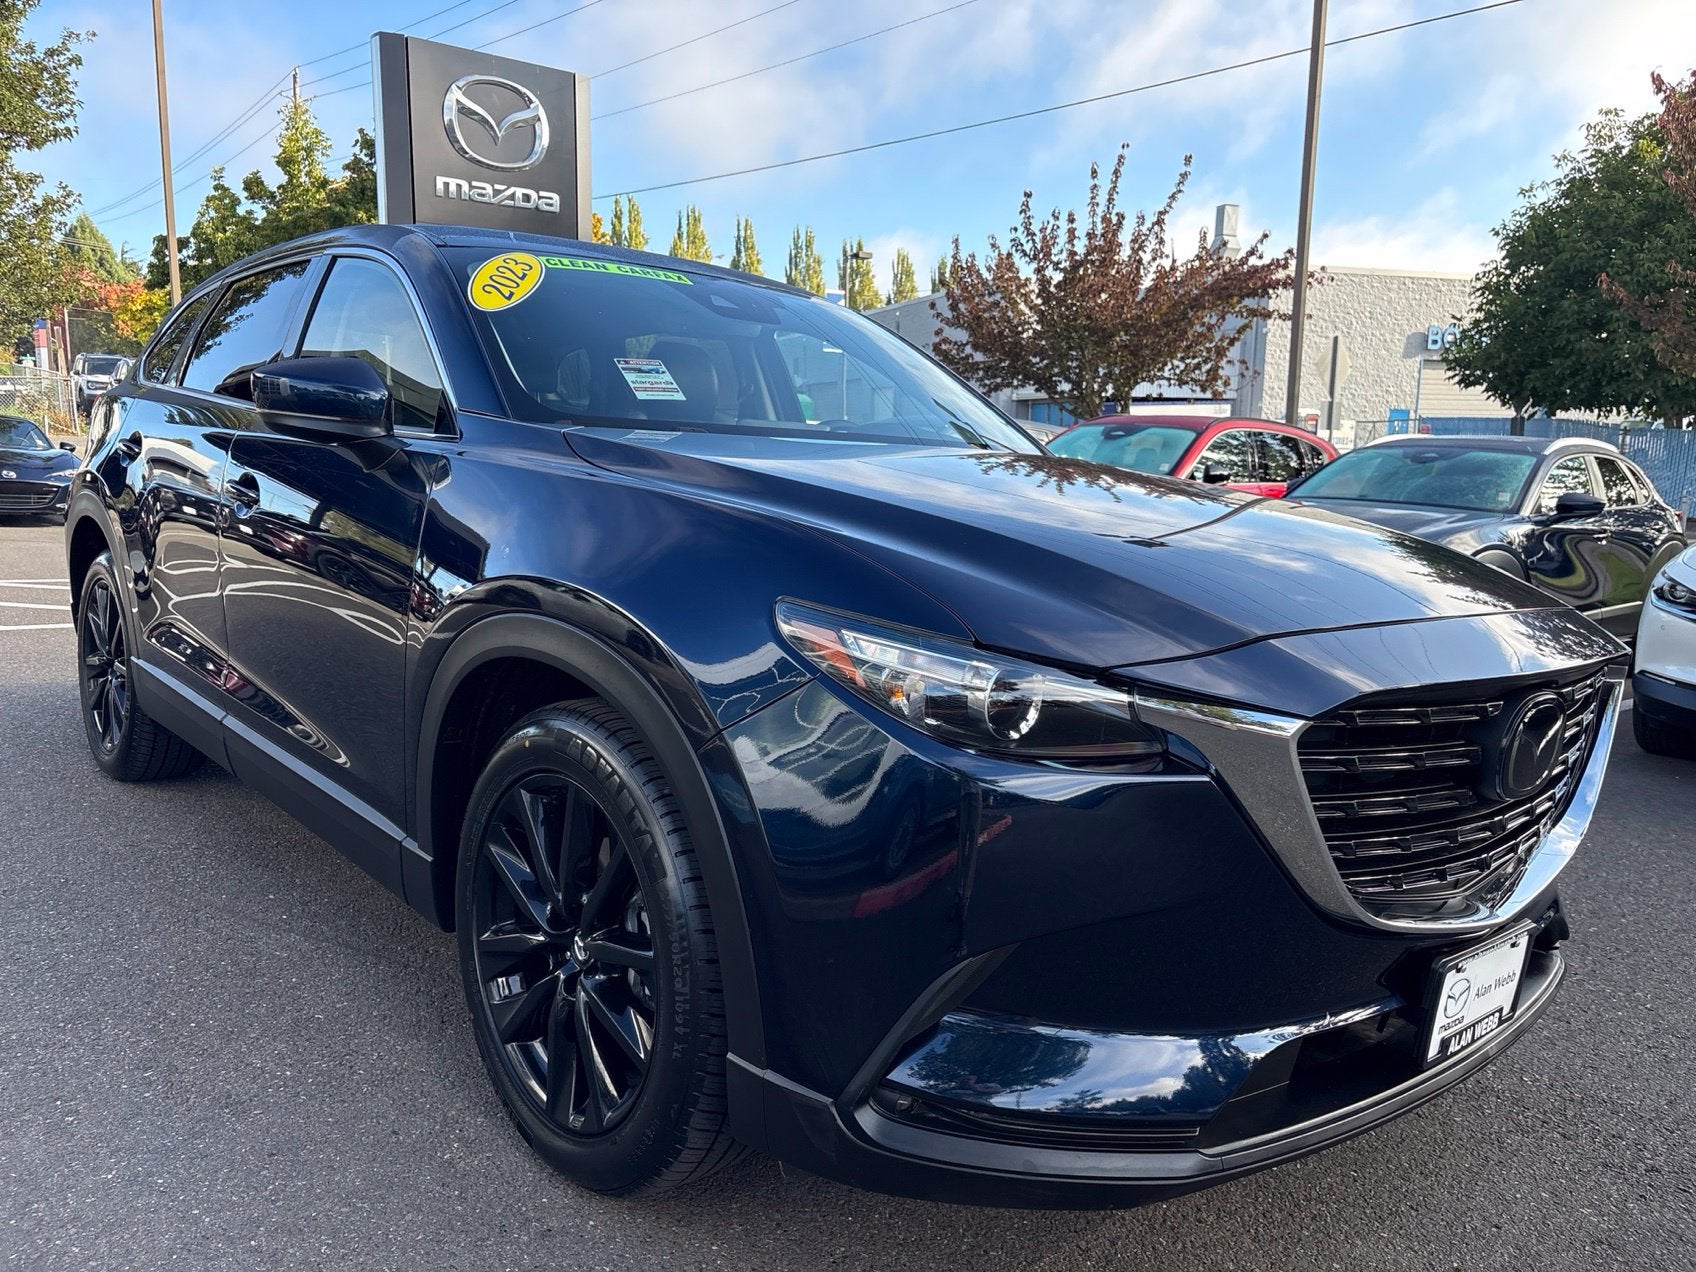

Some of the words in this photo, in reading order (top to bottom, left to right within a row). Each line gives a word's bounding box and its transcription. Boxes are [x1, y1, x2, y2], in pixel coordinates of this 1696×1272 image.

[436, 176, 560, 213] mazda
[482, 257, 533, 301] 2023
[545, 257, 611, 272] CLEAN
[616, 264, 689, 283] CARFAX
[1473, 983, 1492, 1001] Alan
[1494, 969, 1517, 990] Webb
[1438, 1015, 1465, 1035] mazda
[1447, 1026, 1474, 1056] ALAN
[1474, 1012, 1500, 1040] WEBB
